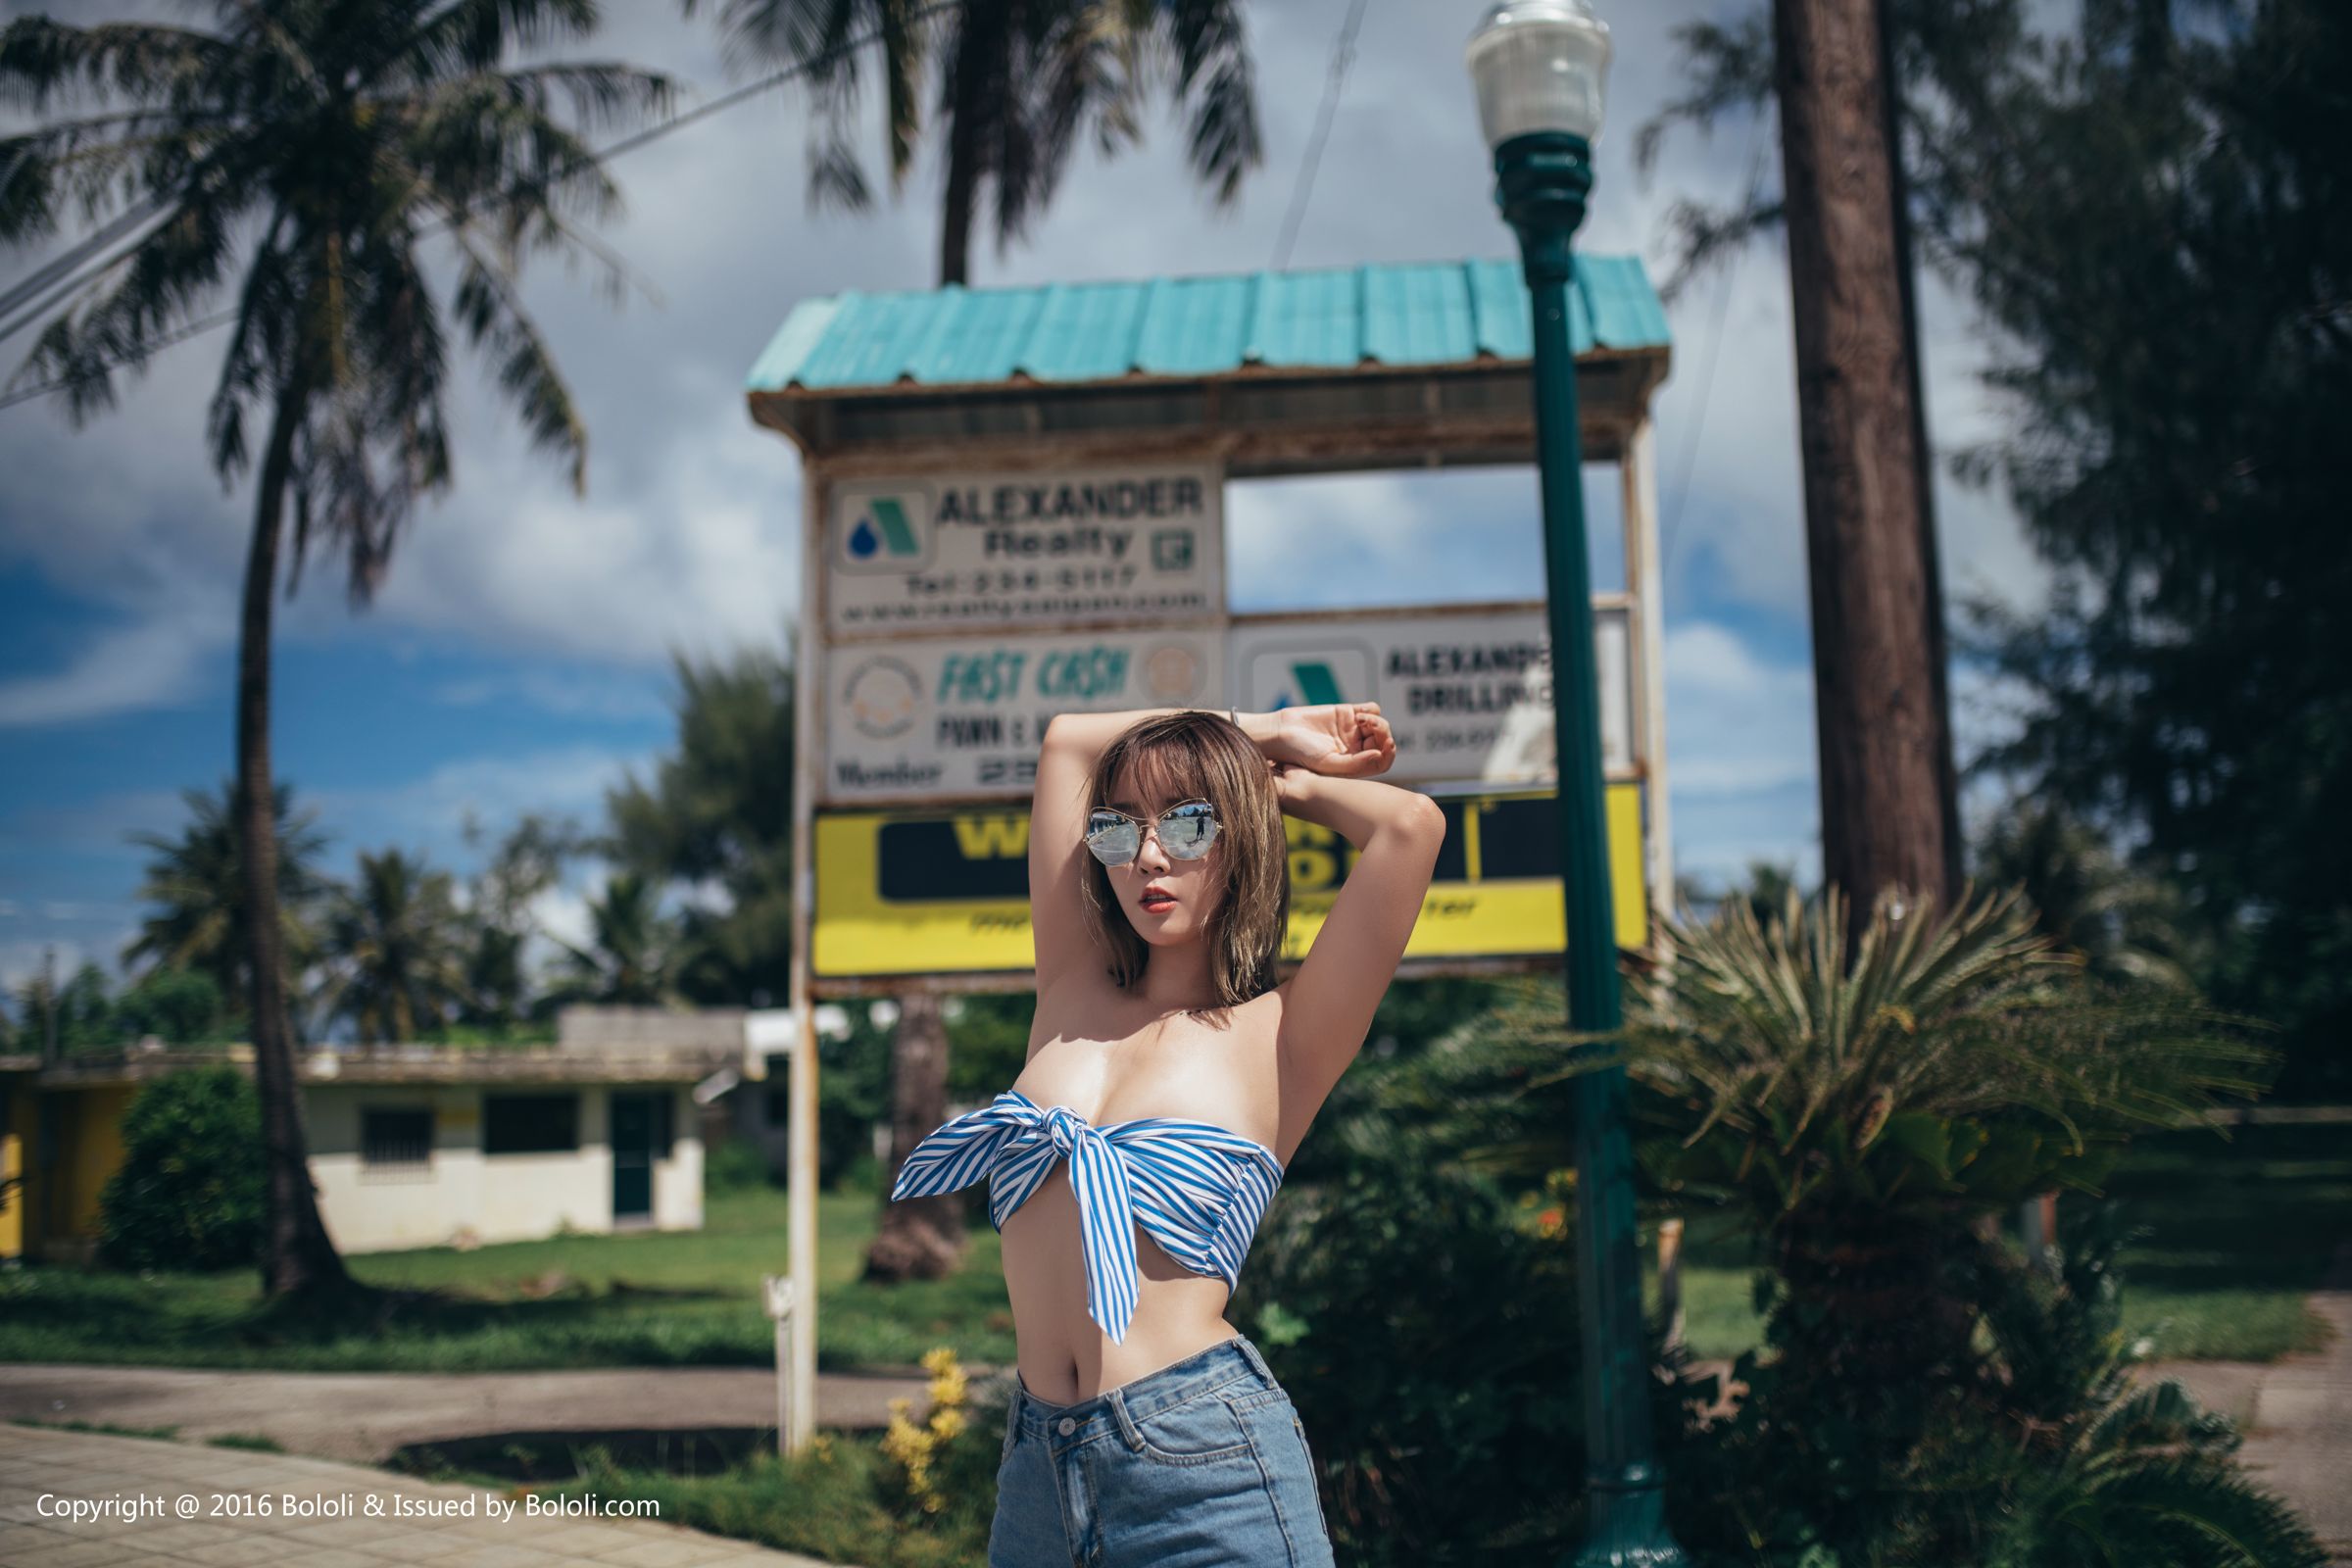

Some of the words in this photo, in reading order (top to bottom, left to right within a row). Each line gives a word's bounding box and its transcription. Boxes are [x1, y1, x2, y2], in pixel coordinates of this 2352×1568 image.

[937, 478, 1202, 524] ALEXANDER
[984, 524, 1133, 562] Realty
[1386, 643, 1552, 676] ALEXAND
[837, 755, 944, 787] Member
